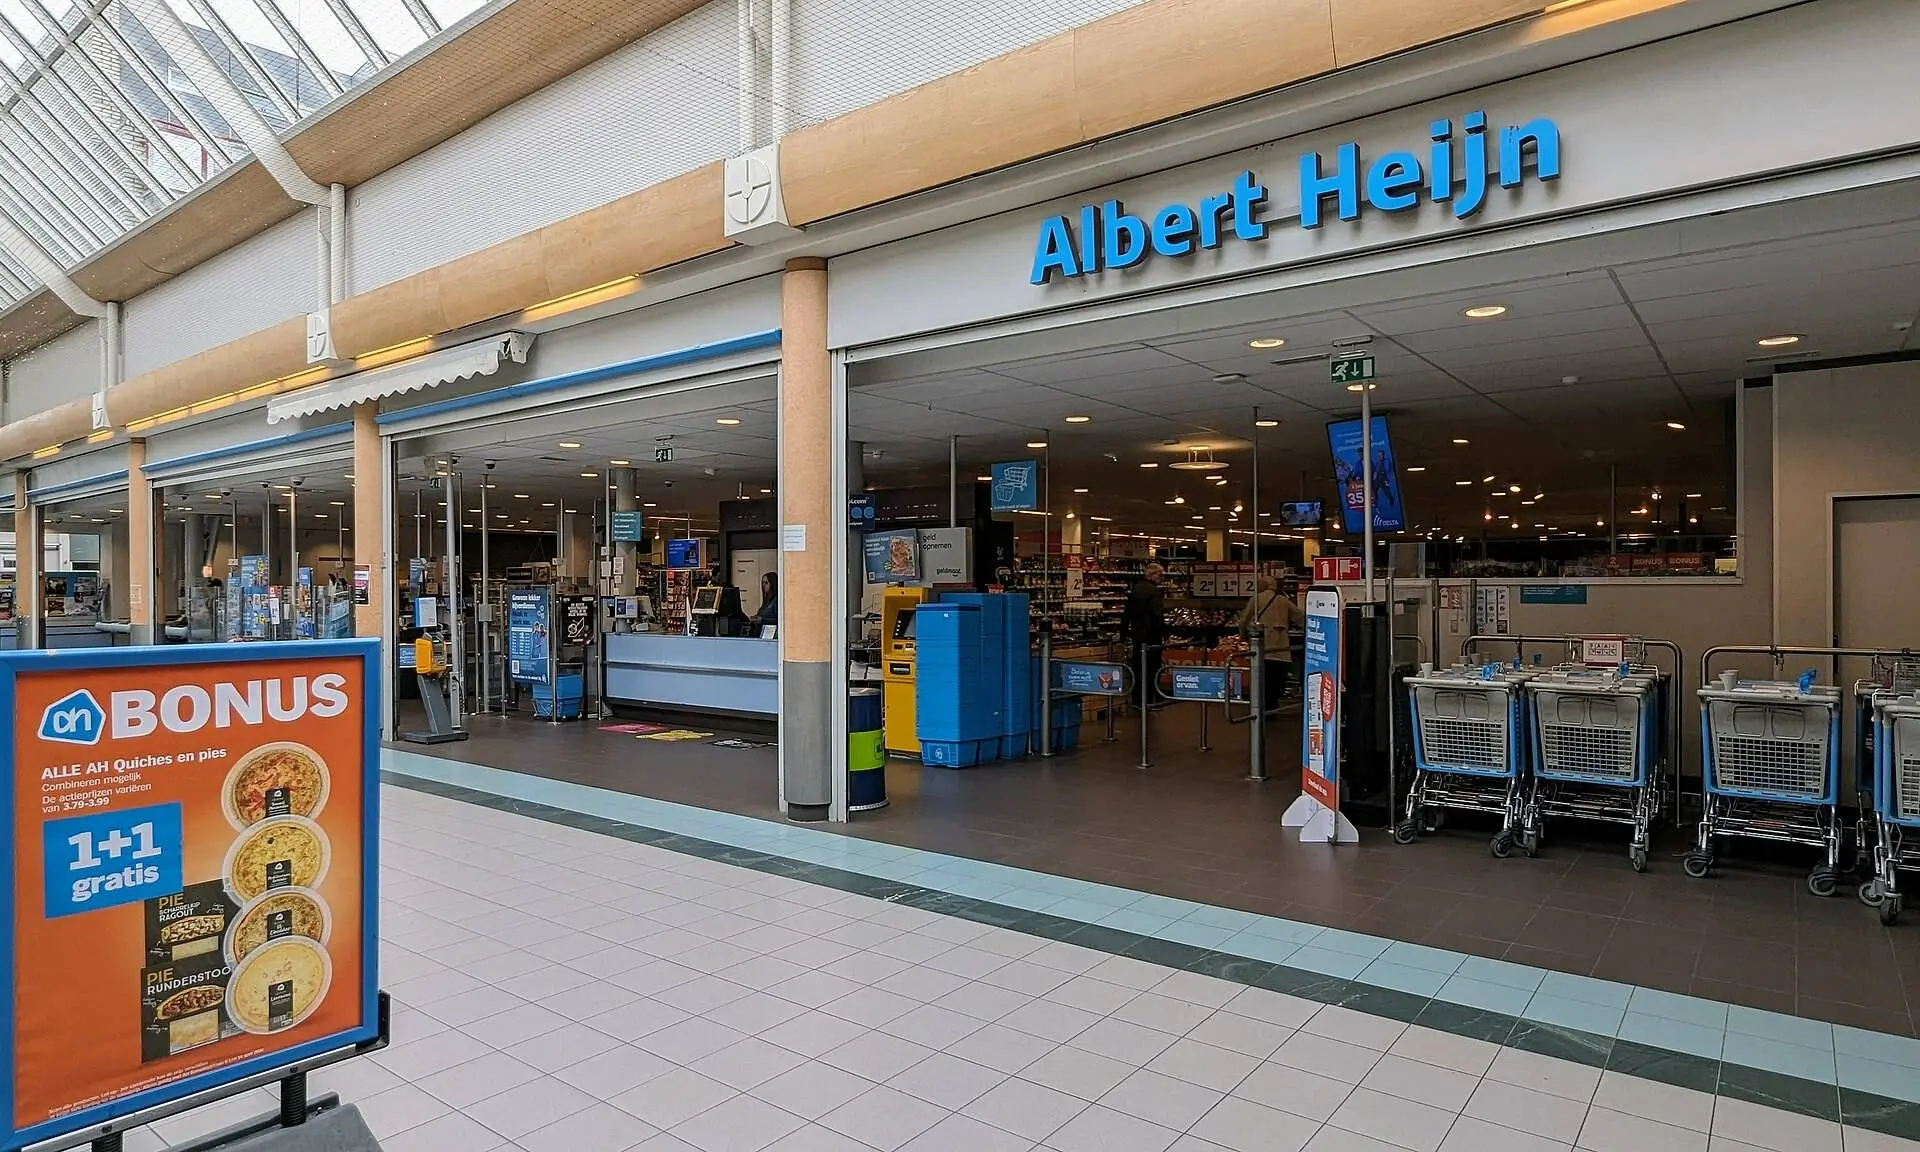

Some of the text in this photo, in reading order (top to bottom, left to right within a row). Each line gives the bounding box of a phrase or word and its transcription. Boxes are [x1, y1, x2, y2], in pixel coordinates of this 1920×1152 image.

[1030, 110, 1561, 285] Albert Heijn
[922, 533, 936, 543] geld
[922, 541, 952, 551] opnemen
[1176, 674, 1199, 683] Geniet
[111, 673, 348, 740] BONUS
[42, 748, 227, 779] ALLE AH Quiches en pies
[42, 772, 142, 792] Combineren mogelijk
[42, 783, 152, 805] De actieprijzen variëren
[42, 797, 110, 814] van 3.79-3.99
[68, 822, 162, 872] 1+1
[72, 864, 160, 902] gratis
[159, 893, 184, 910] PIE
[159, 908, 194, 922] RAGOUT
[147, 967, 174, 986] PIE
[147, 966, 231, 996] RUNDERSTOO
